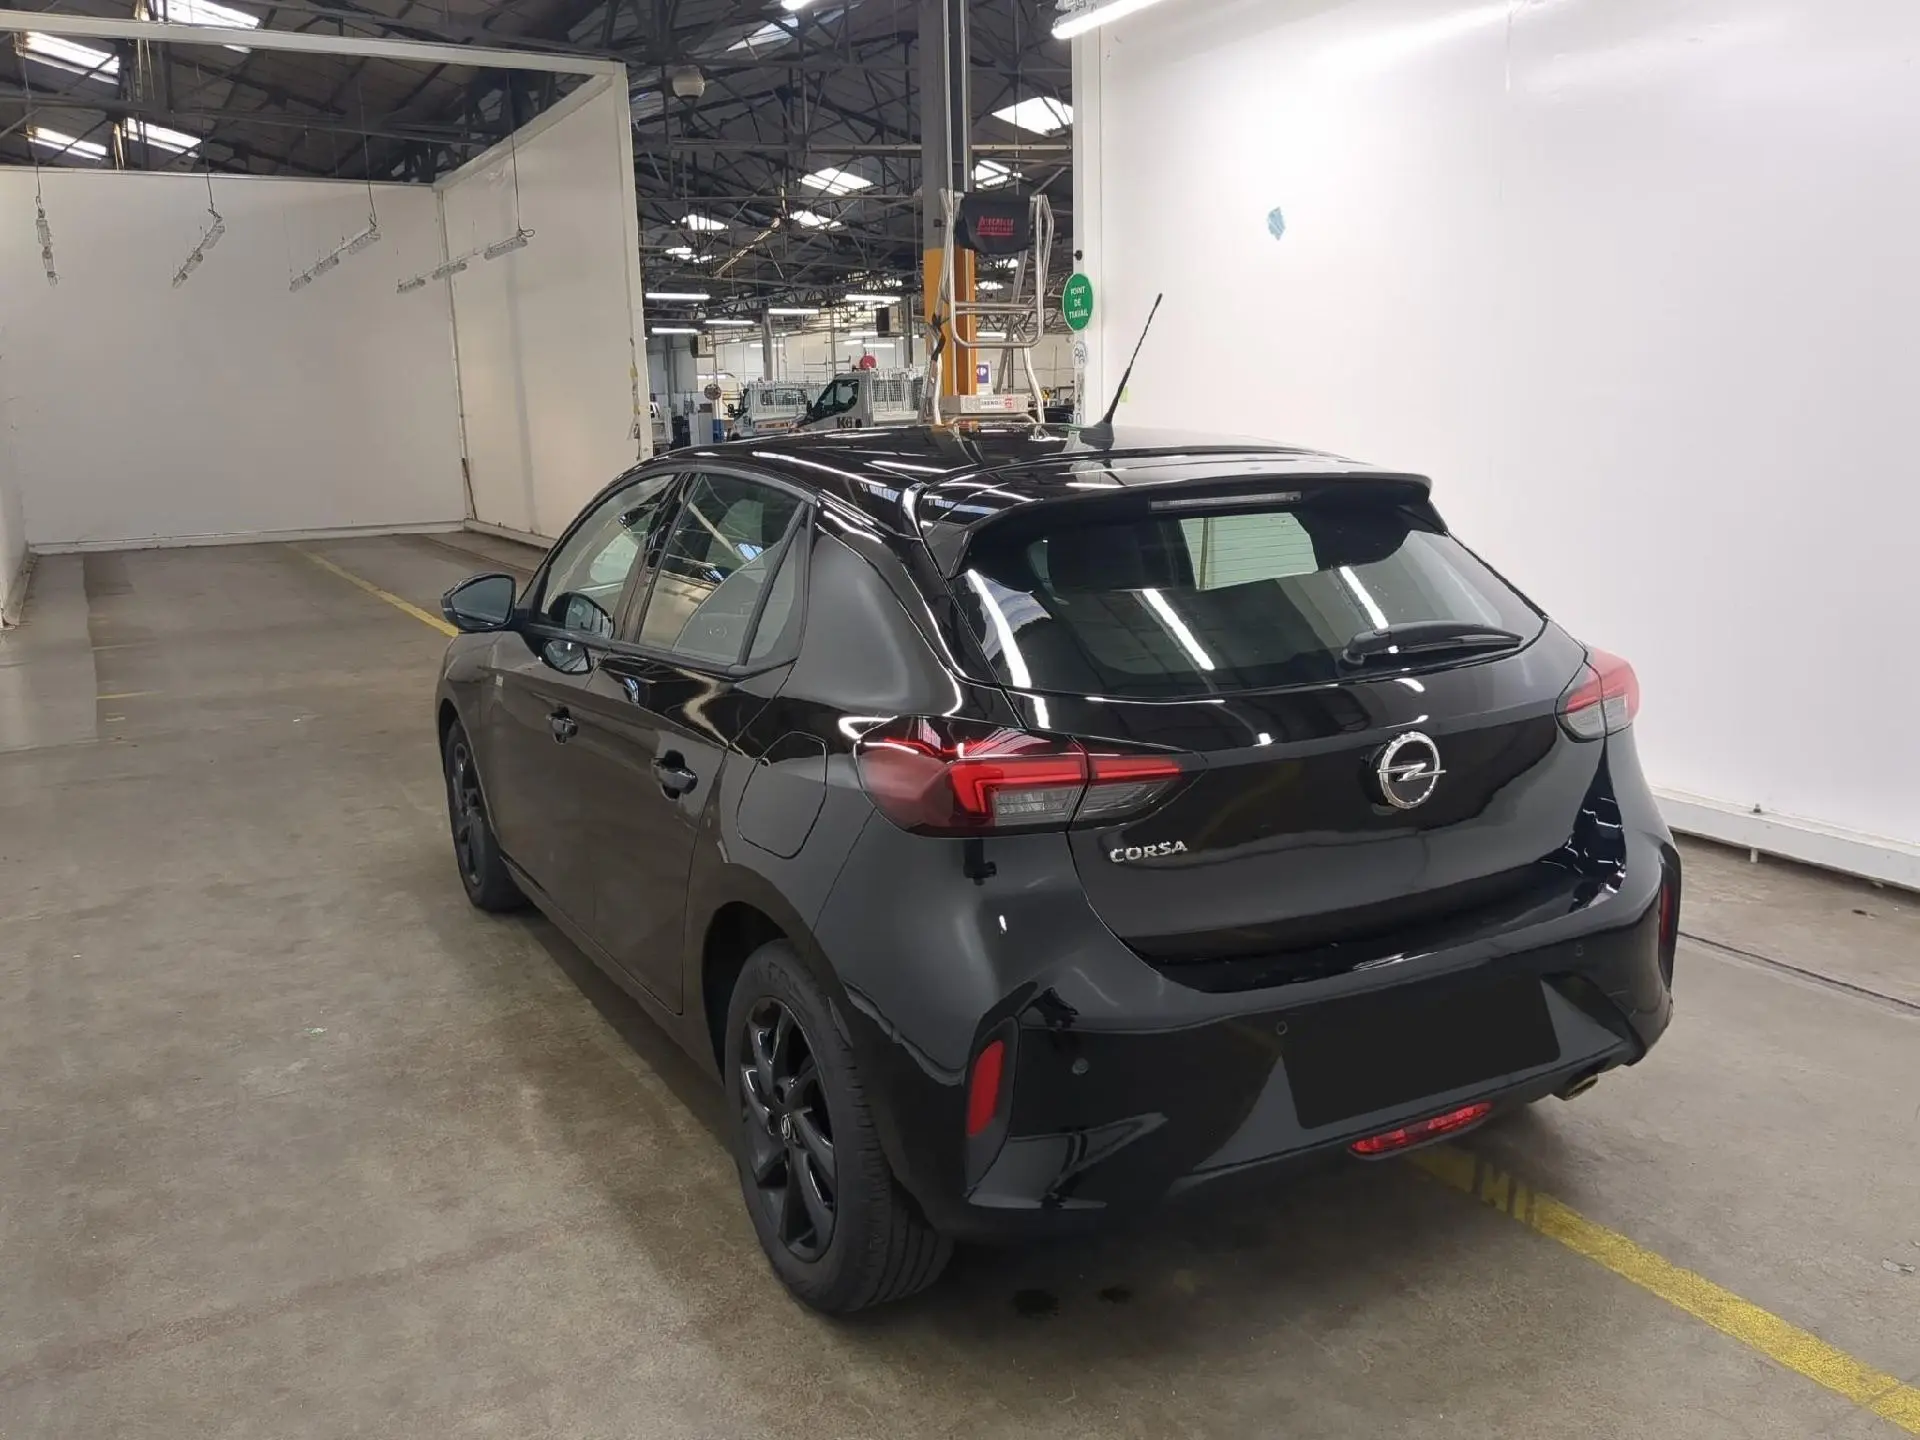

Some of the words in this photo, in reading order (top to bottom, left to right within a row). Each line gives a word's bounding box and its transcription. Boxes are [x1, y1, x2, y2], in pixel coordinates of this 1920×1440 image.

[1070, 286, 1086, 296] POINT
[1073, 298, 1082, 308] DE
[1068, 309, 1089, 320] TRAVAIL
[1109, 840, 1189, 863] CORSA
